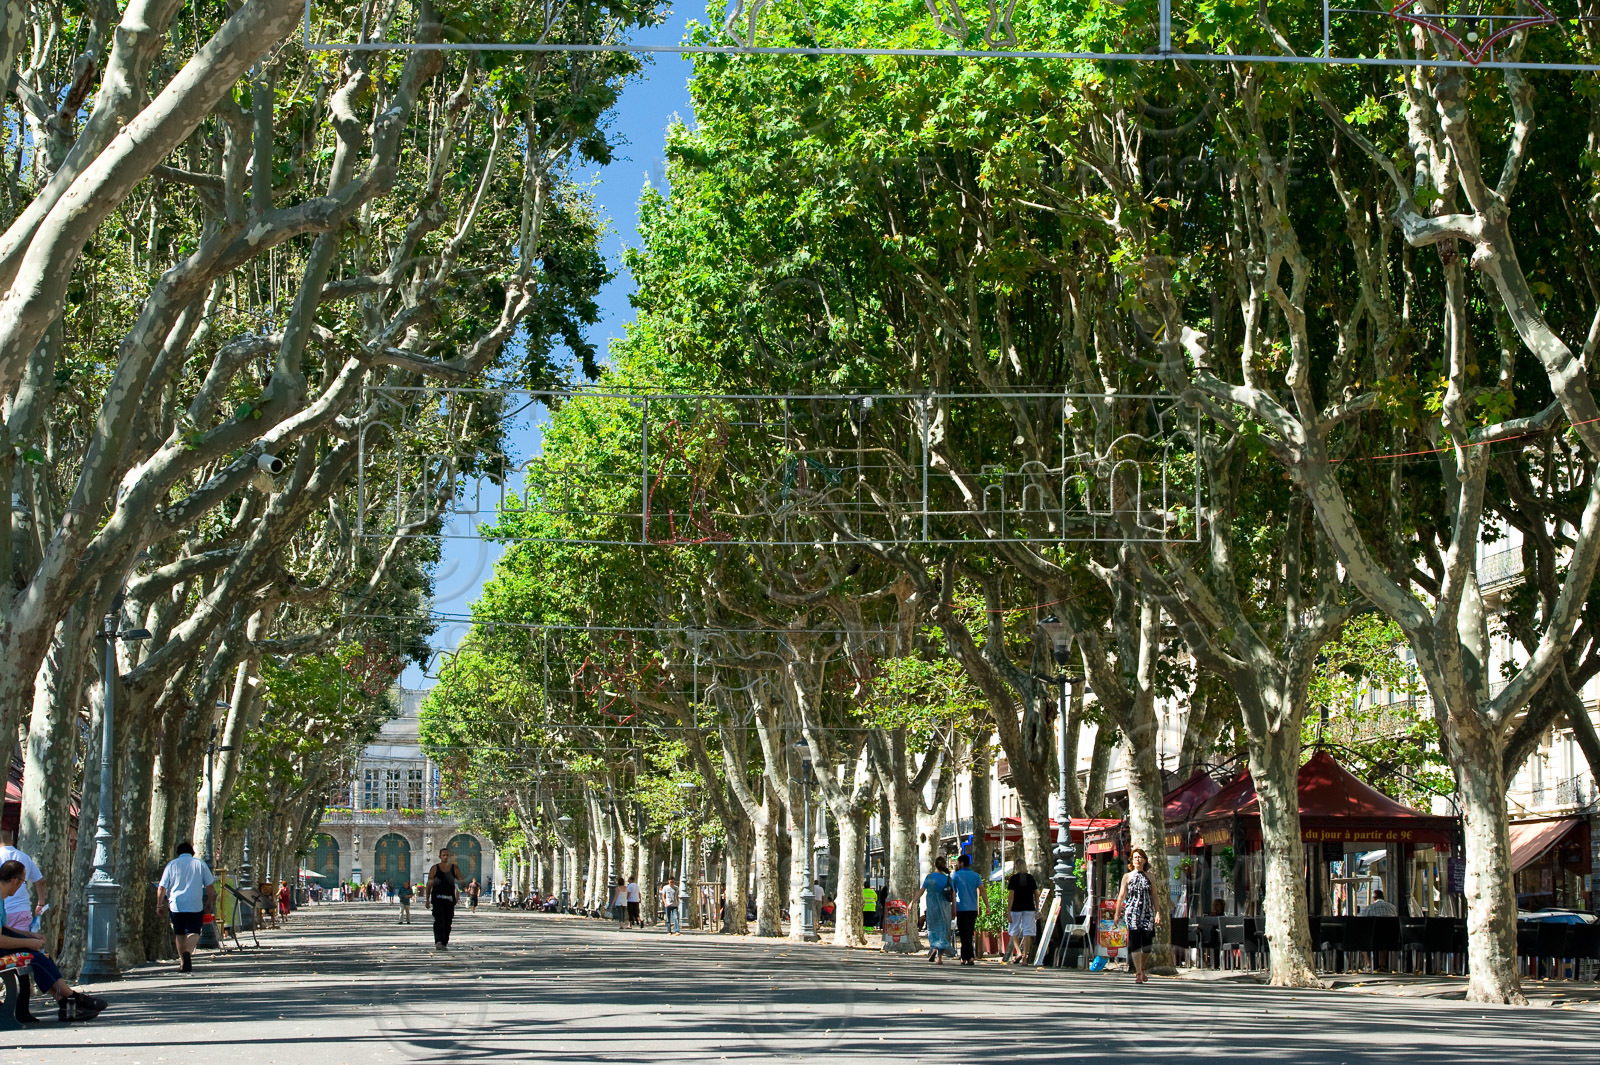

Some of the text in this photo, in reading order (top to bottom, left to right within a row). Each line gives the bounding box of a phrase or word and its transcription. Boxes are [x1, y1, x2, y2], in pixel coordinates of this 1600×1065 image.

[1305, 829, 1318, 839] du
[1320, 829, 1342, 841] jour
[1344, 829, 1351, 839] à
[1353, 830, 1384, 841] partir
[1386, 830, 1398, 840] de
[1400, 830, 1413, 840] 9€
